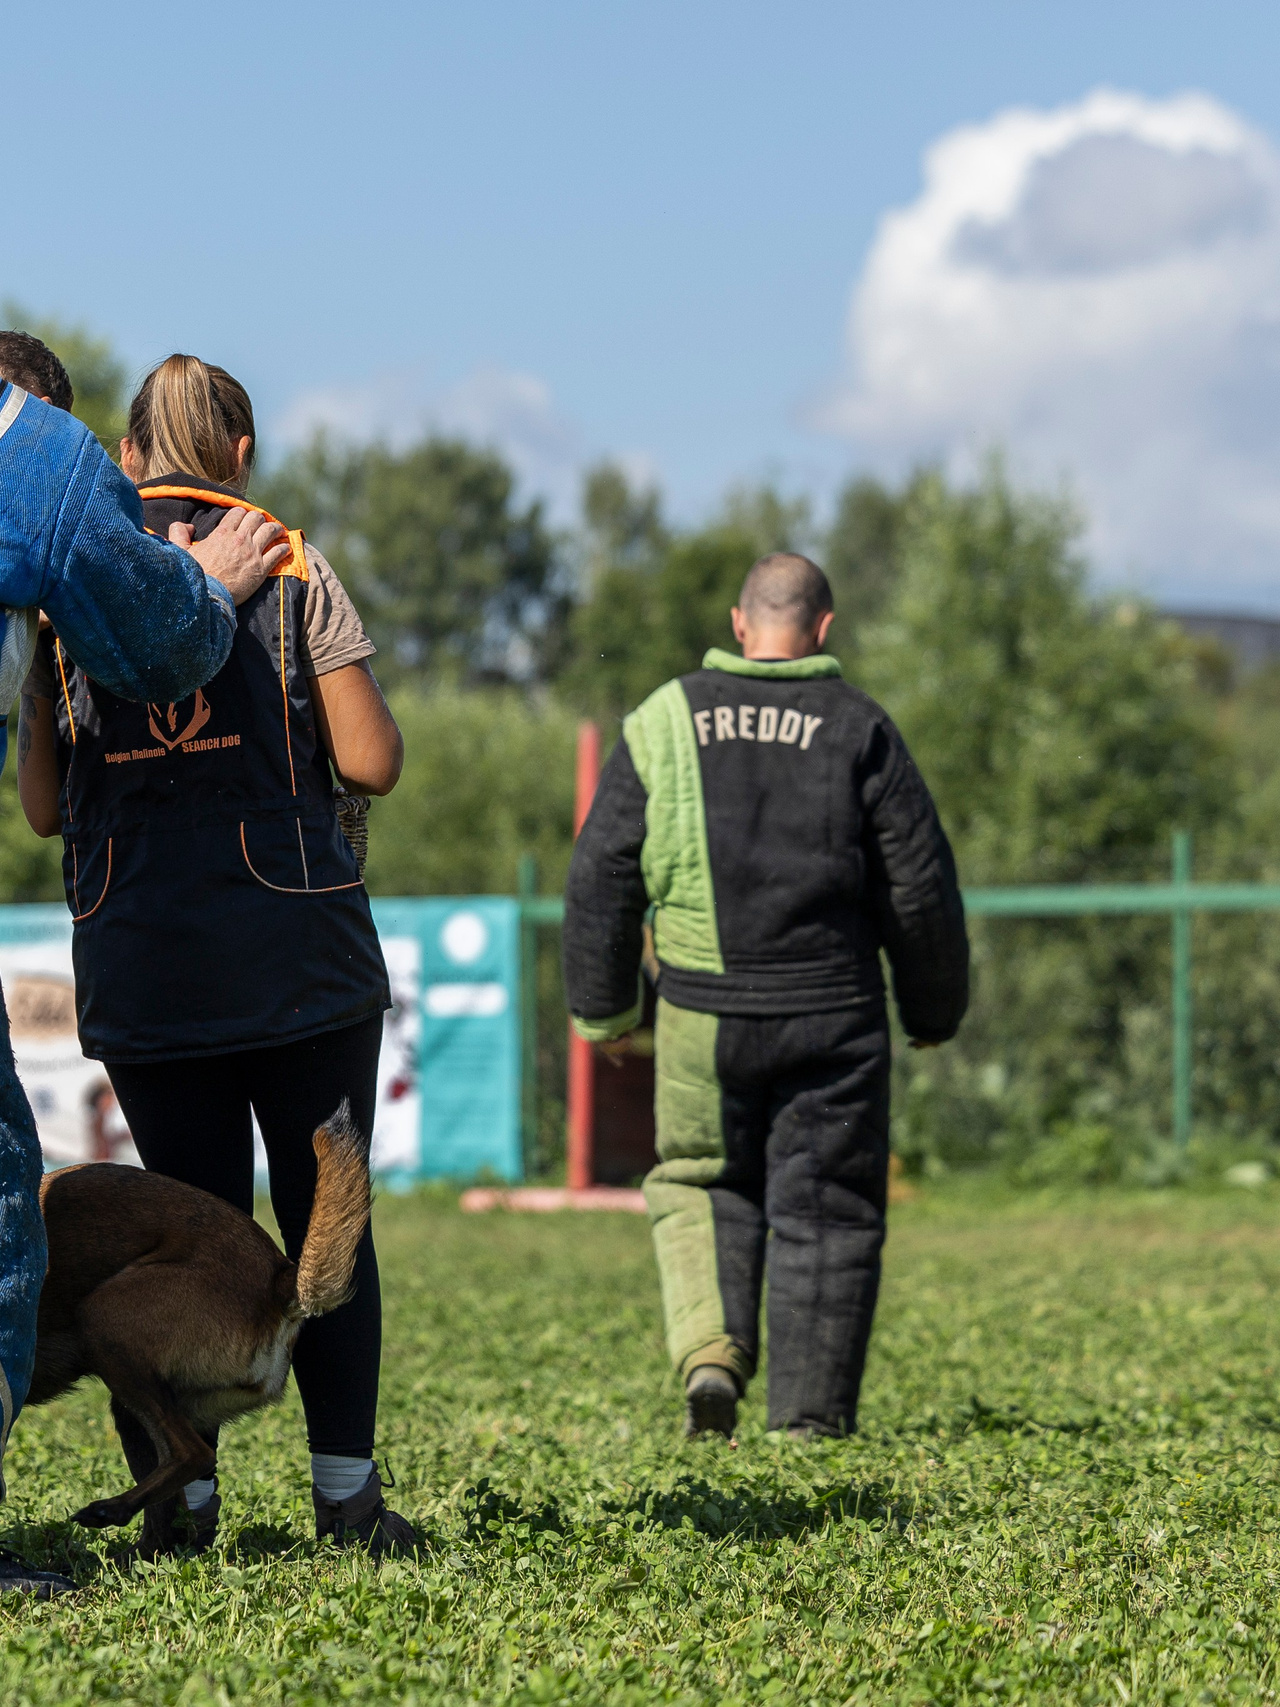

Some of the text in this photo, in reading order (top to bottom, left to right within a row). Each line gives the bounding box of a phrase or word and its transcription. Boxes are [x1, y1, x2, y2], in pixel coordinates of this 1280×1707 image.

[693, 705, 824, 750] FREDDY
[181, 734, 241, 753] SEARCH DOG
[104, 747, 166, 763] Belgian Malinois
